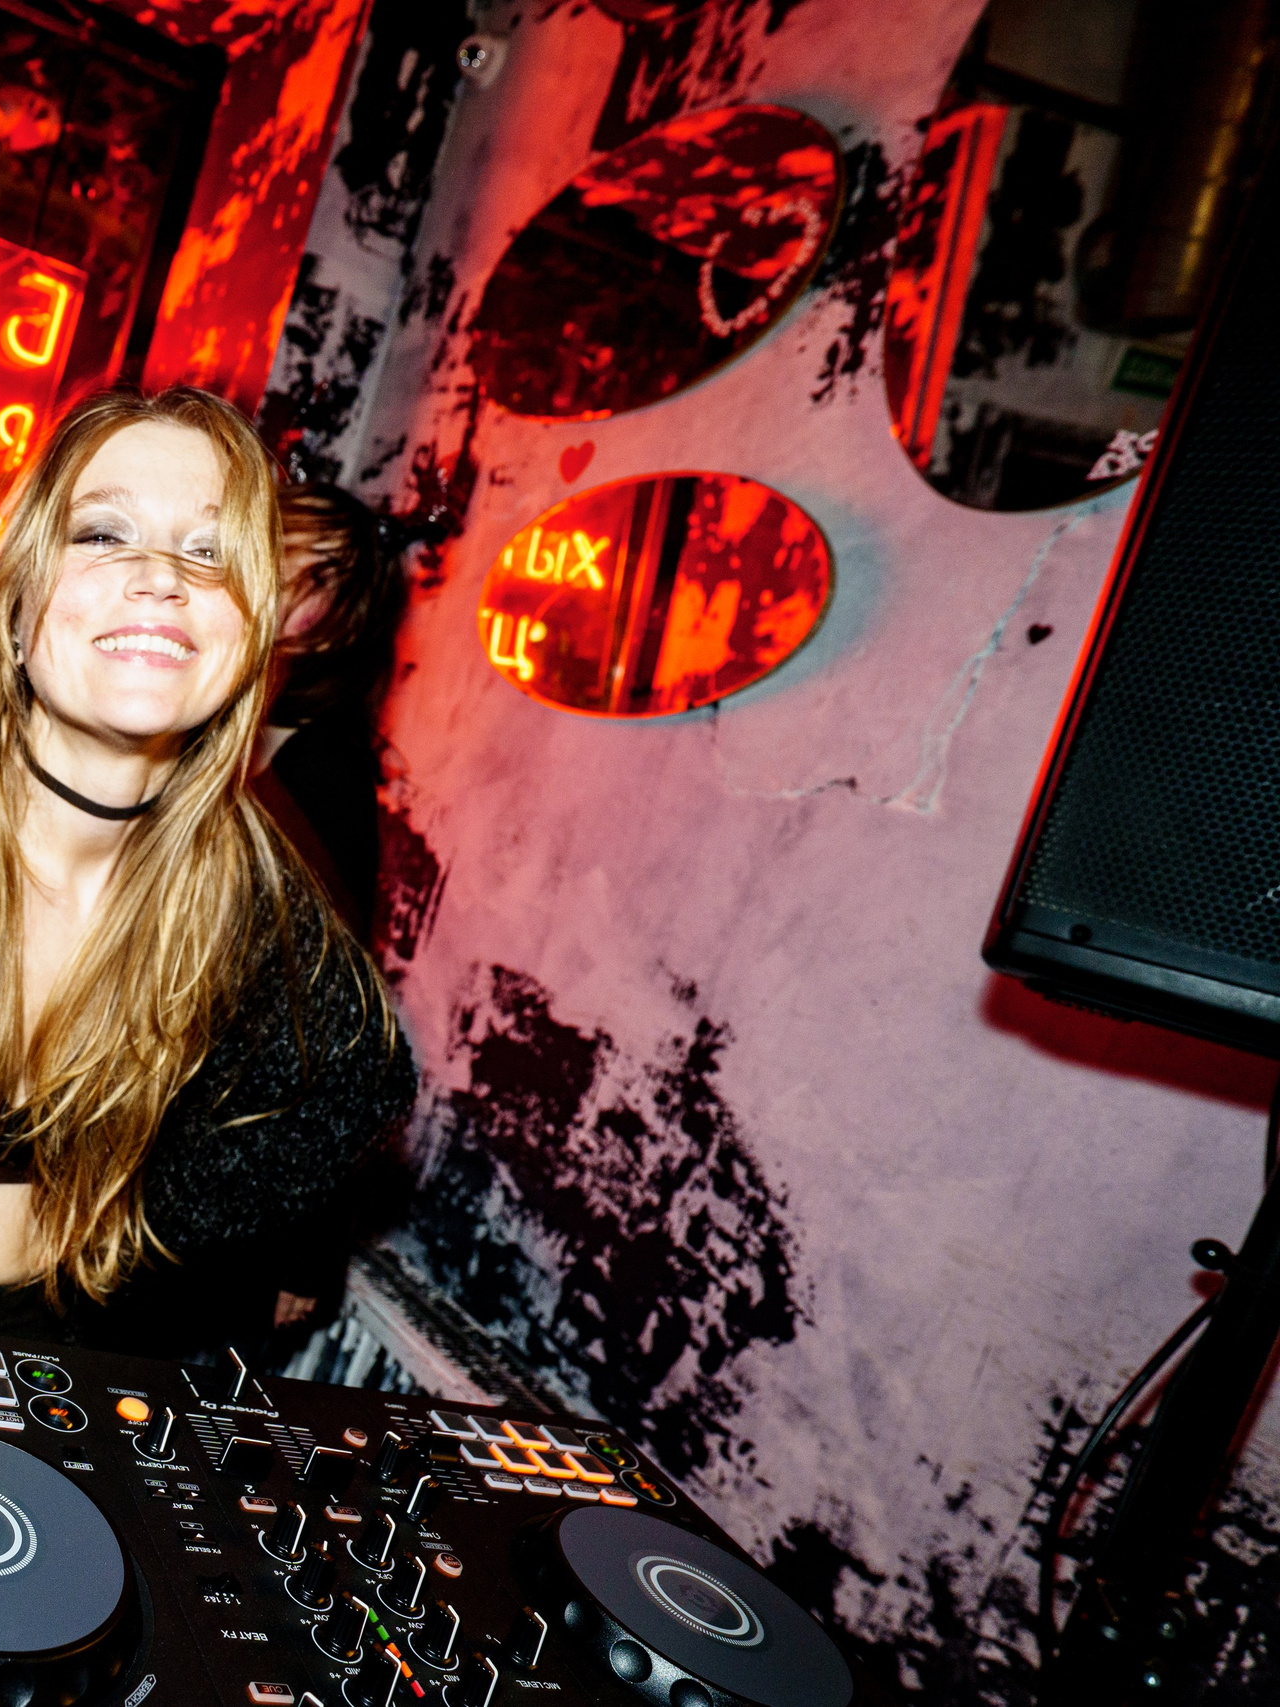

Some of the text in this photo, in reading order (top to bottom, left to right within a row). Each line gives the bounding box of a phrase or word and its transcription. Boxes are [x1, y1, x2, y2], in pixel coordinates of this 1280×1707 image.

[12, 1350, 60, 1362] PLAY/PAUSE
[221, 1404, 280, 1418] Pioneer
[136, 1460, 190, 1471] LEVEL/DEPTH
[244, 1484, 256, 1494] 2
[330, 1494, 339, 1503] 1
[172, 1502, 194, 1510] BEAT
[186, 1546, 211, 1554] SELECT
[314, 1614, 330, 1622] OW
[408, 1622, 425, 1630] OW
[221, 1629, 268, 1641] BEAT FX
[443, 1674, 460, 1682] MID
[262, 1684, 283, 1693] CUE
[516, 1680, 561, 1690] MIC LEVEL
[132, 1681, 152, 1704] SEARCH
